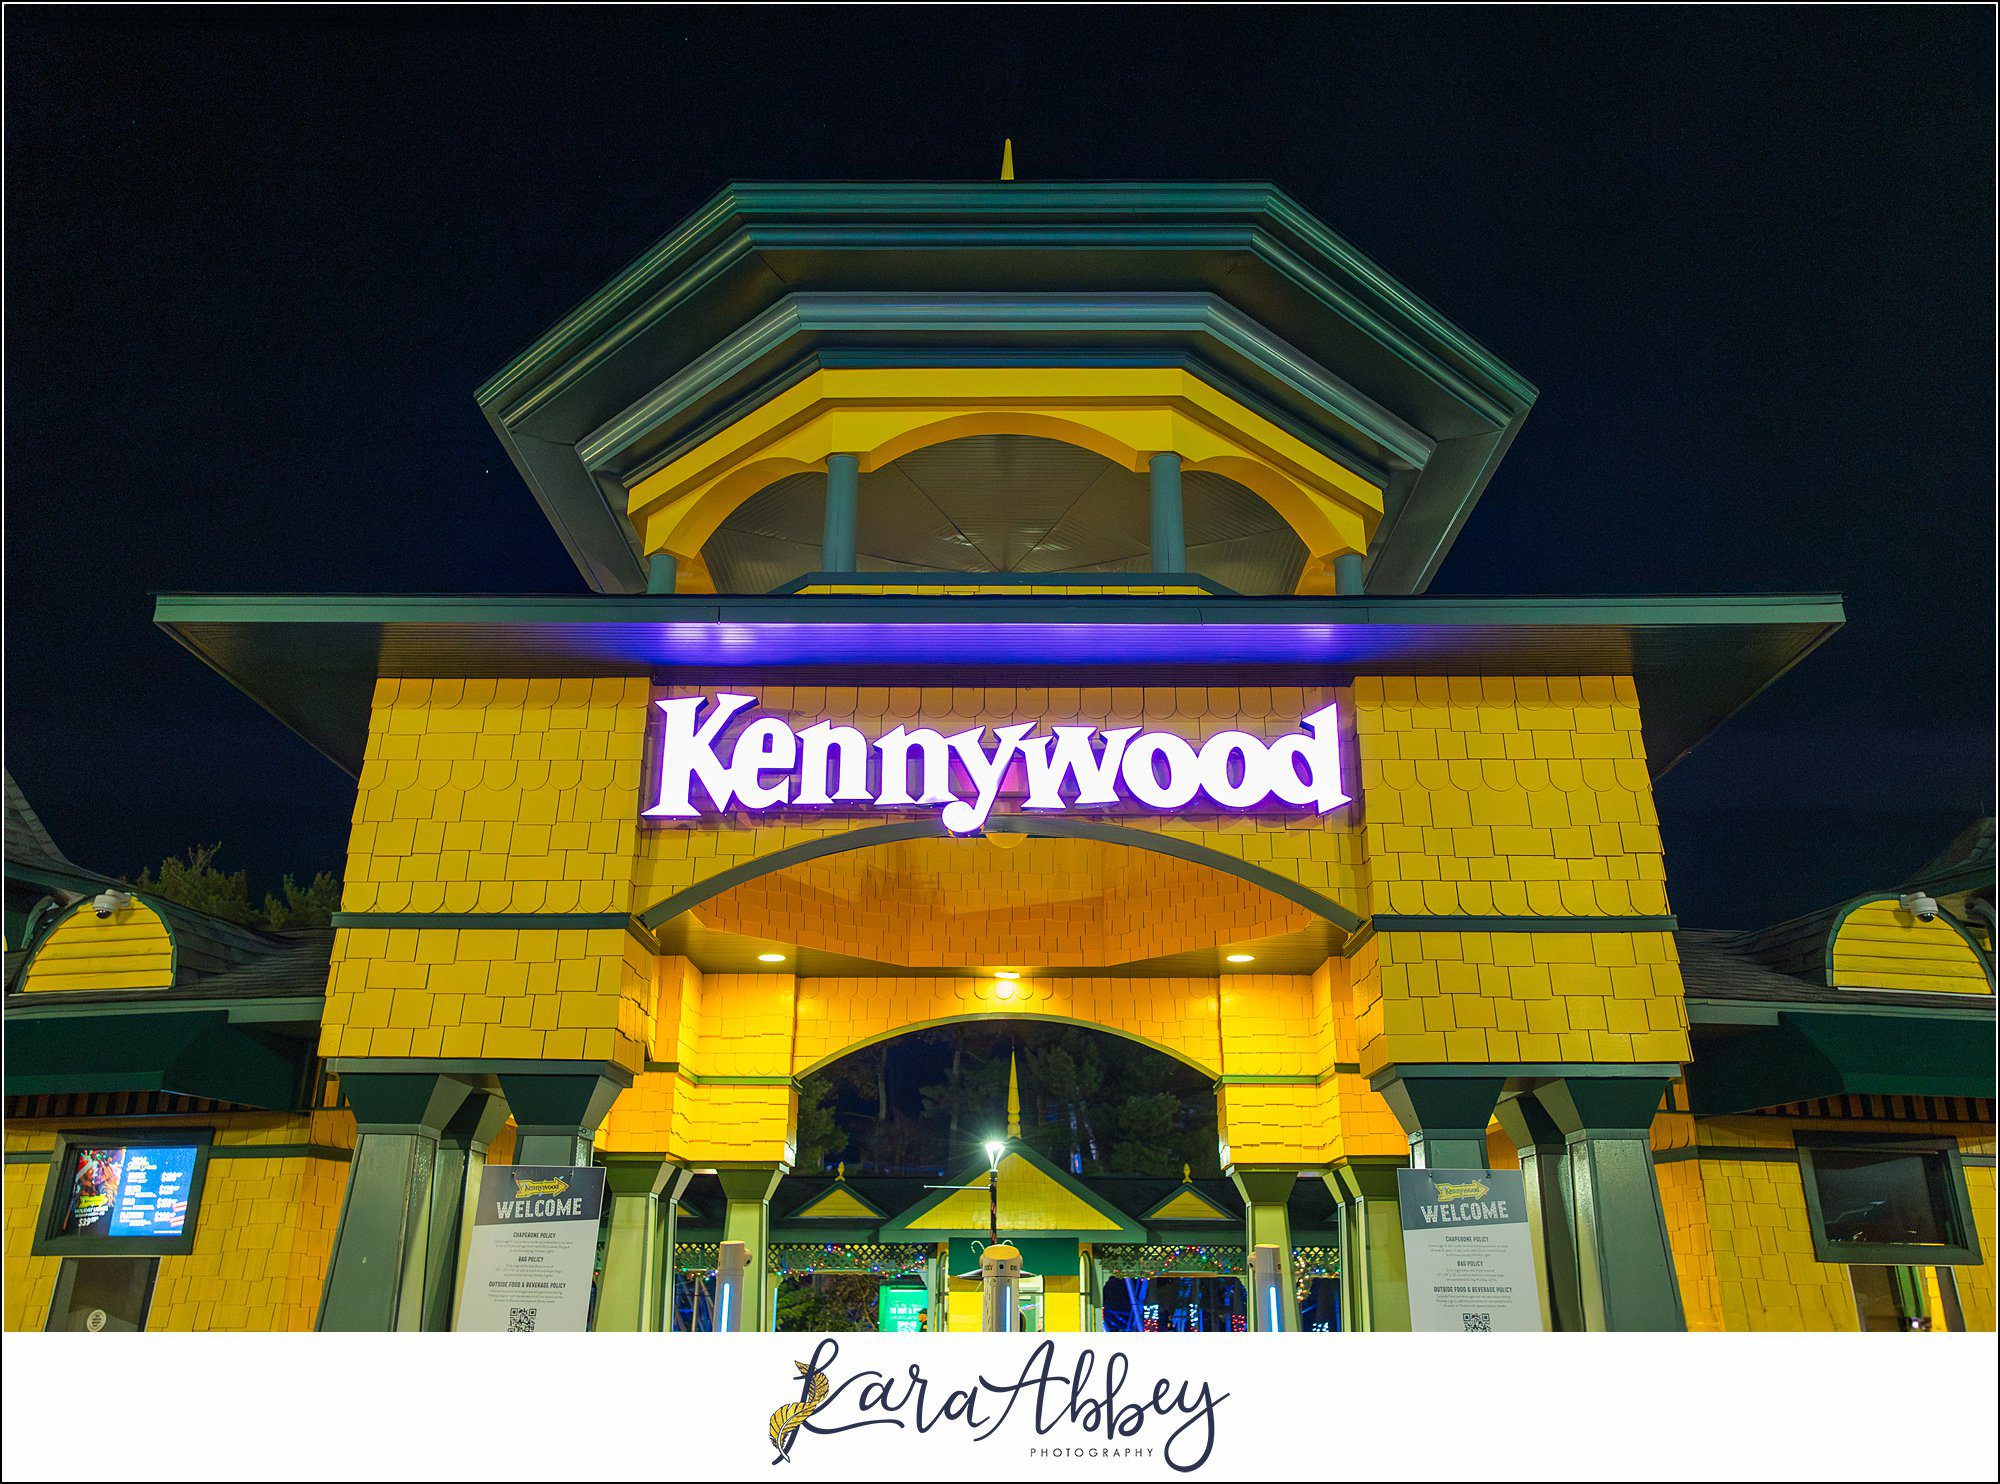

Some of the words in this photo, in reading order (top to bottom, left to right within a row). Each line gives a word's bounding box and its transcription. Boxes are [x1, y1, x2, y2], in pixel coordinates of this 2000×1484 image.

[641, 693, 1352, 834] Kennywood
[525, 1183, 560, 1192] Kennywood
[496, 1198, 582, 1219] WELCOME
[1420, 1200, 1509, 1223] WELCOME
[513, 1231, 539, 1239] CHAPERONE
[526, 1281, 550, 1289] BEVERAGE
